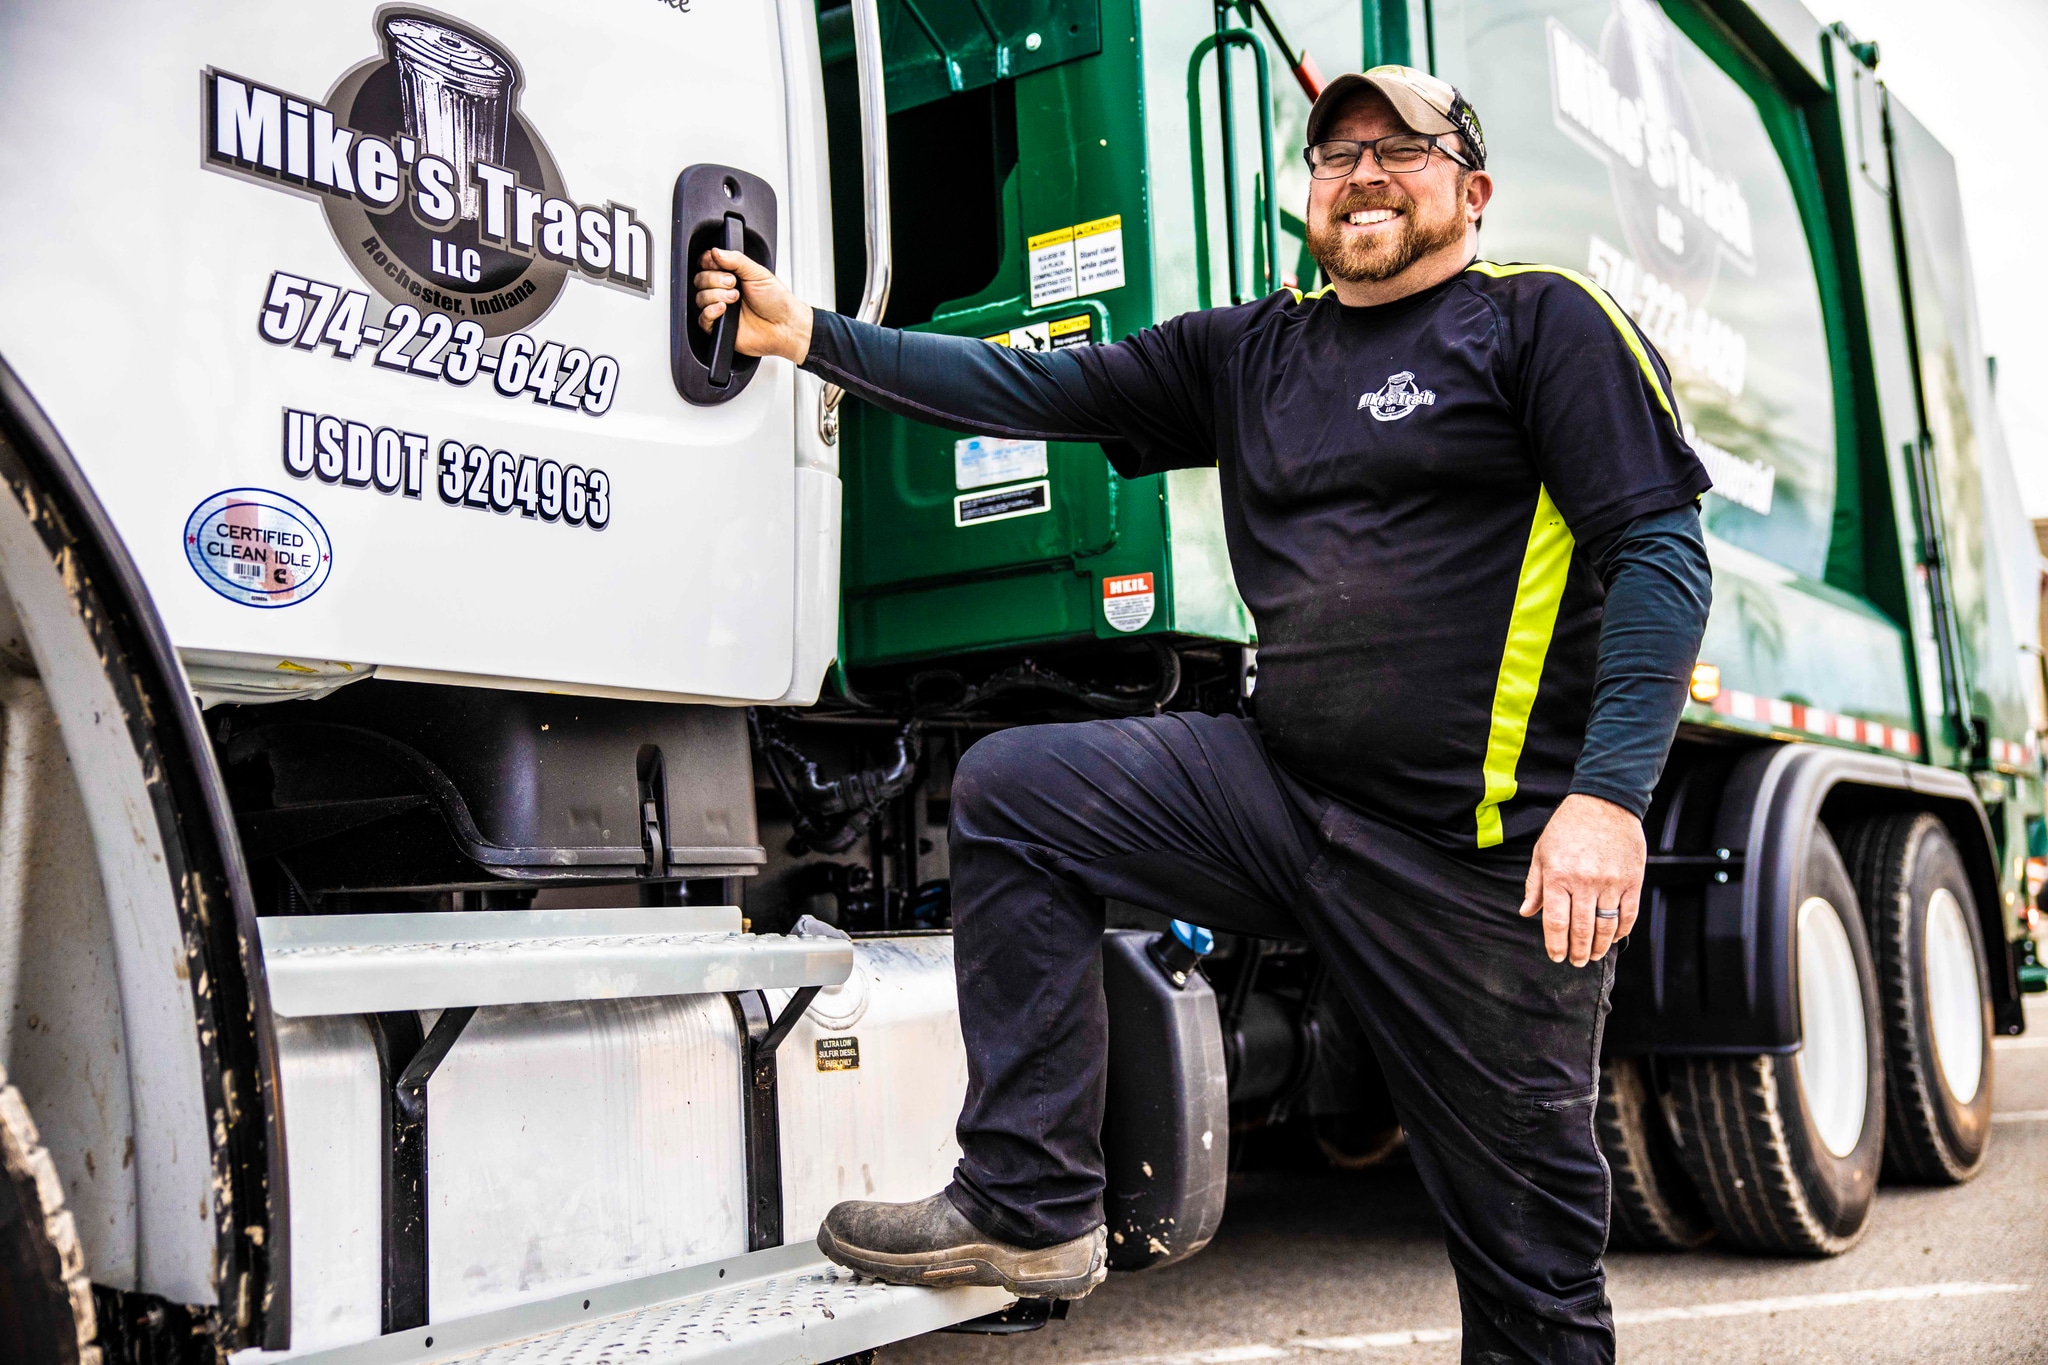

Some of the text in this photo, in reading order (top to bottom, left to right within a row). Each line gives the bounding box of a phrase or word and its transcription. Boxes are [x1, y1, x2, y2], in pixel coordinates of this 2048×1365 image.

[216, 75, 647, 281] Mike's Trash
[1084, 219, 1120, 234] CAUTION
[432, 238, 481, 283] LLC
[1080, 246, 1117, 259] Stand clear
[1081, 257, 1117, 271] while panel
[361, 236, 537, 316] Rochester, Indiana
[262, 271, 619, 414] 574-223-6429
[285, 408, 610, 526] USDOT 3264963
[216, 523, 304, 548] CERTIFIED
[207, 541, 312, 568] CLEAN IDLE
[1110, 578, 1149, 595] HEIL
[819, 1048, 857, 1058] SULFUR DIESEL
[822, 1039, 852, 1048] ULTRA LOW
